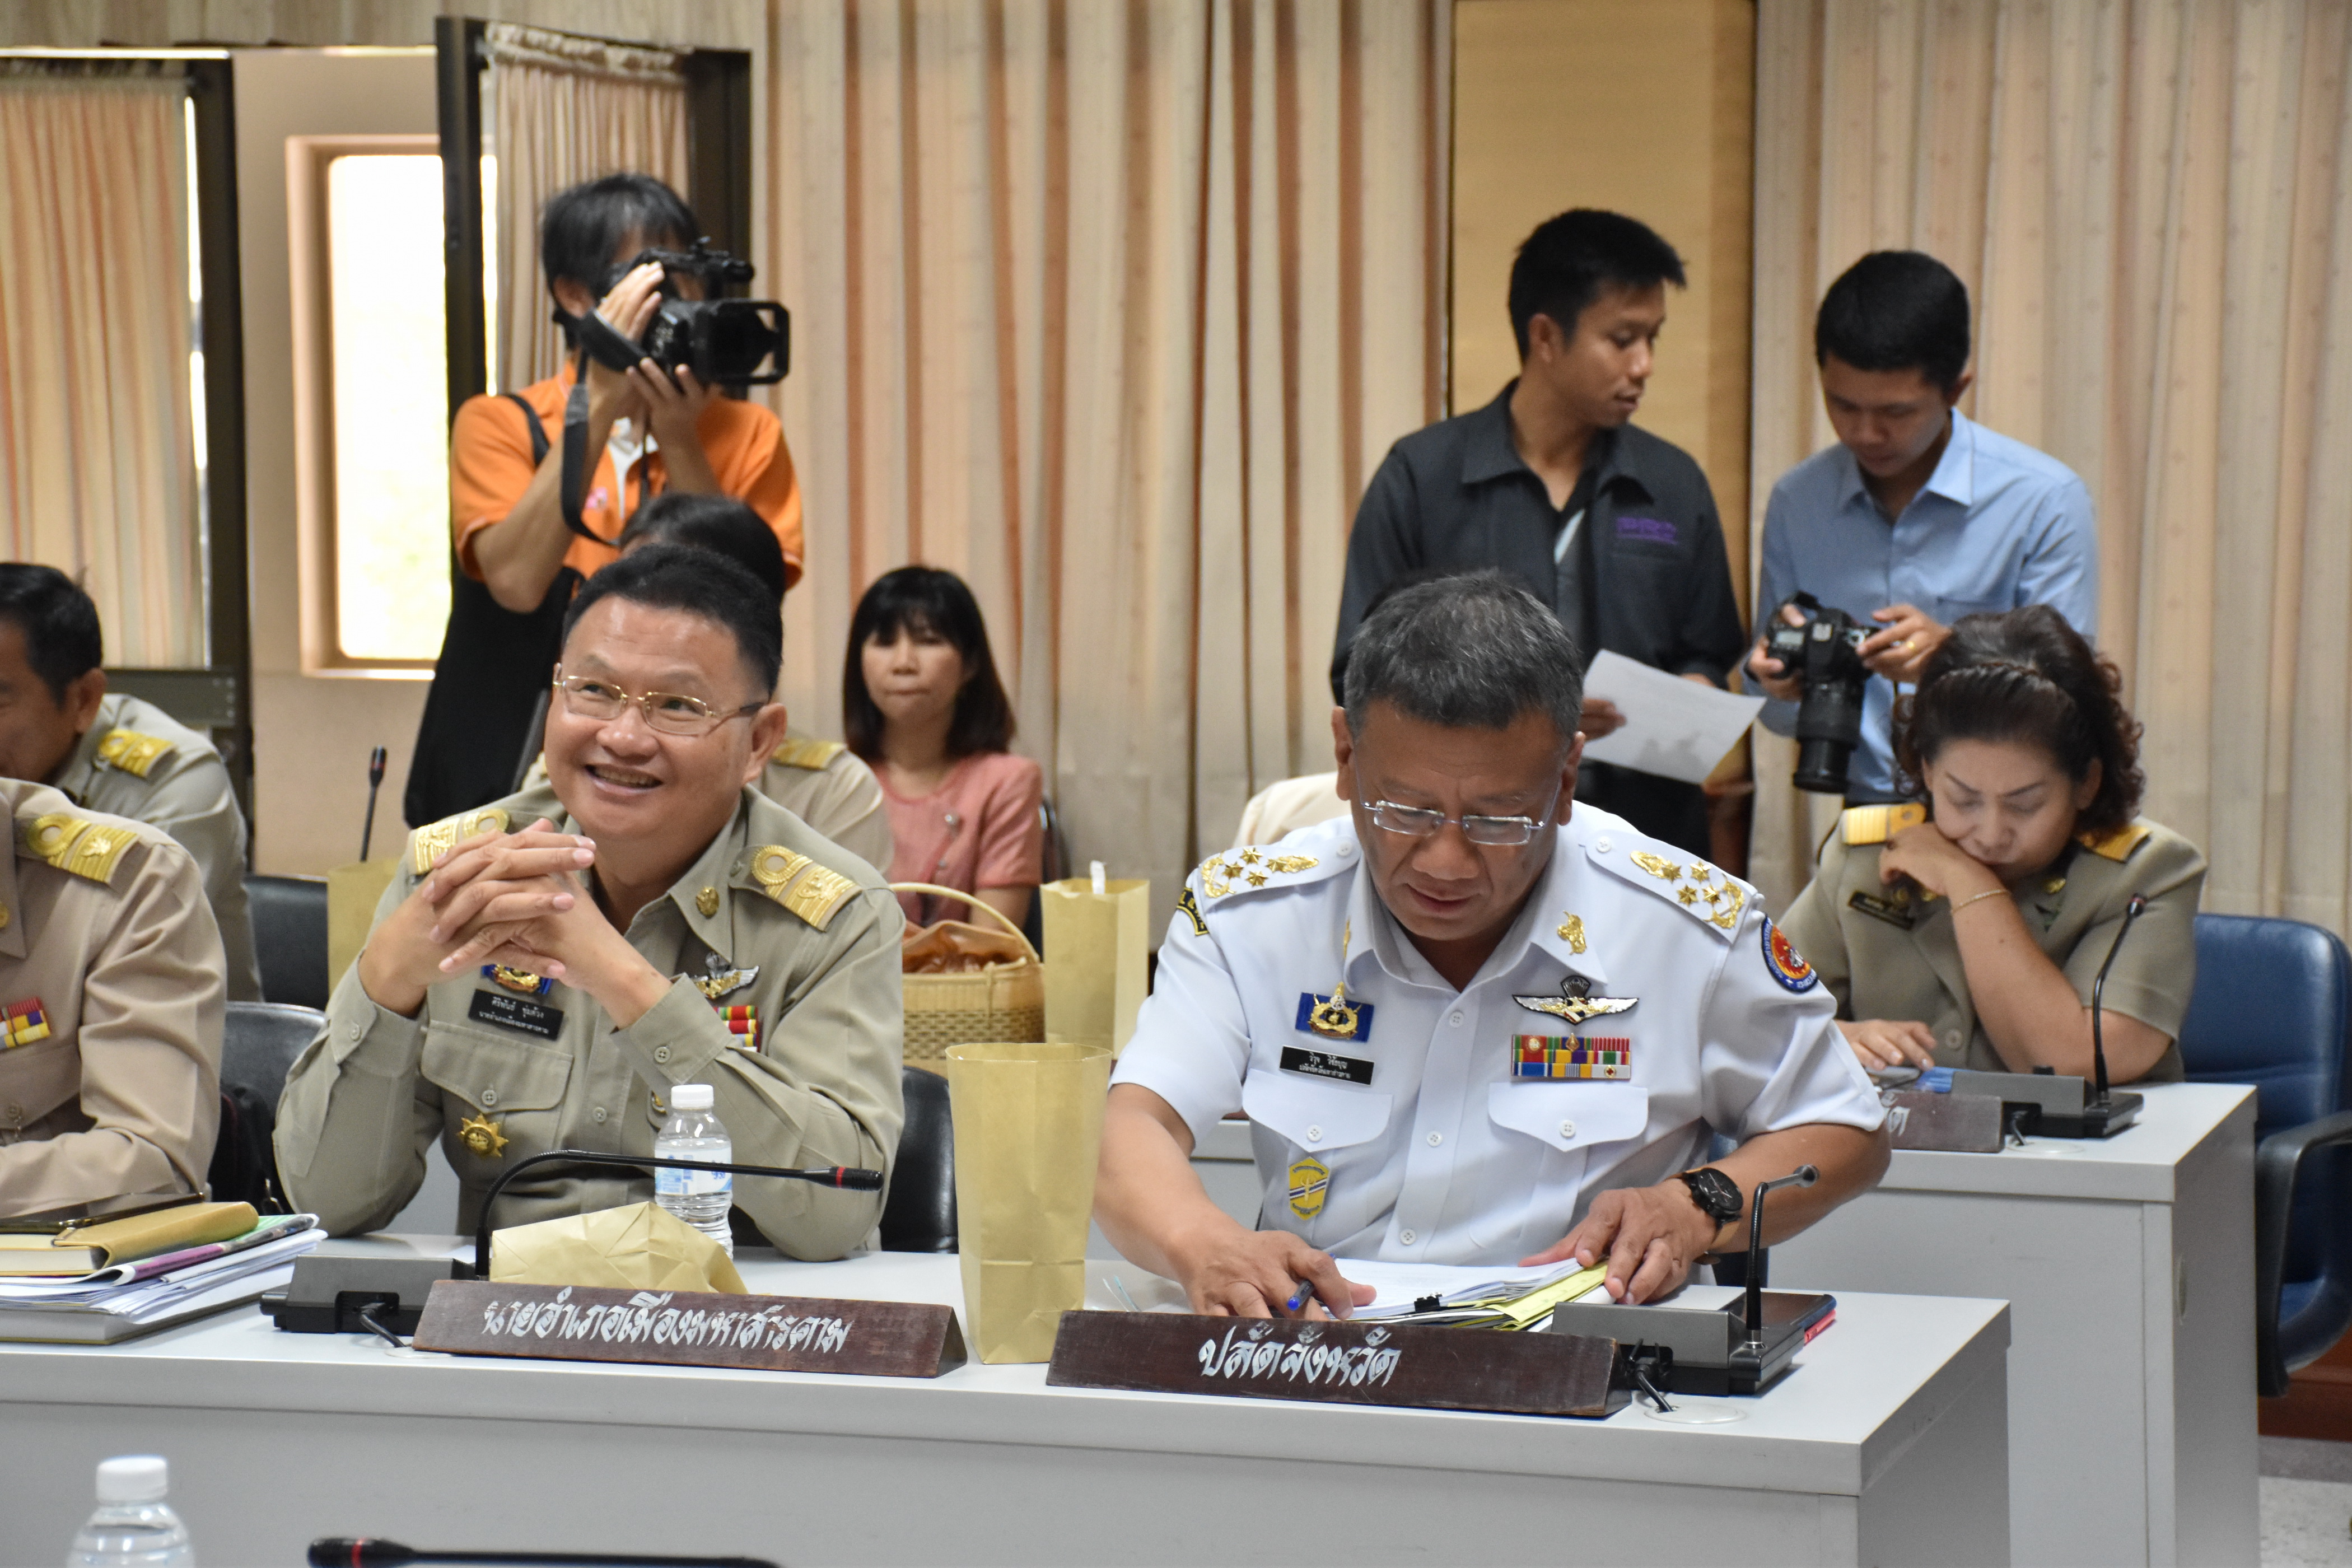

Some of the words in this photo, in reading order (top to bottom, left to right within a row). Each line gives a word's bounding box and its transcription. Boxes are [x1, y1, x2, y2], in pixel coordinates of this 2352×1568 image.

[482, 1286, 854, 1353] นายอำเภอเมืองมหาสารคาม
[1198, 1320, 1402, 1387] ปลัดจังหวัด
